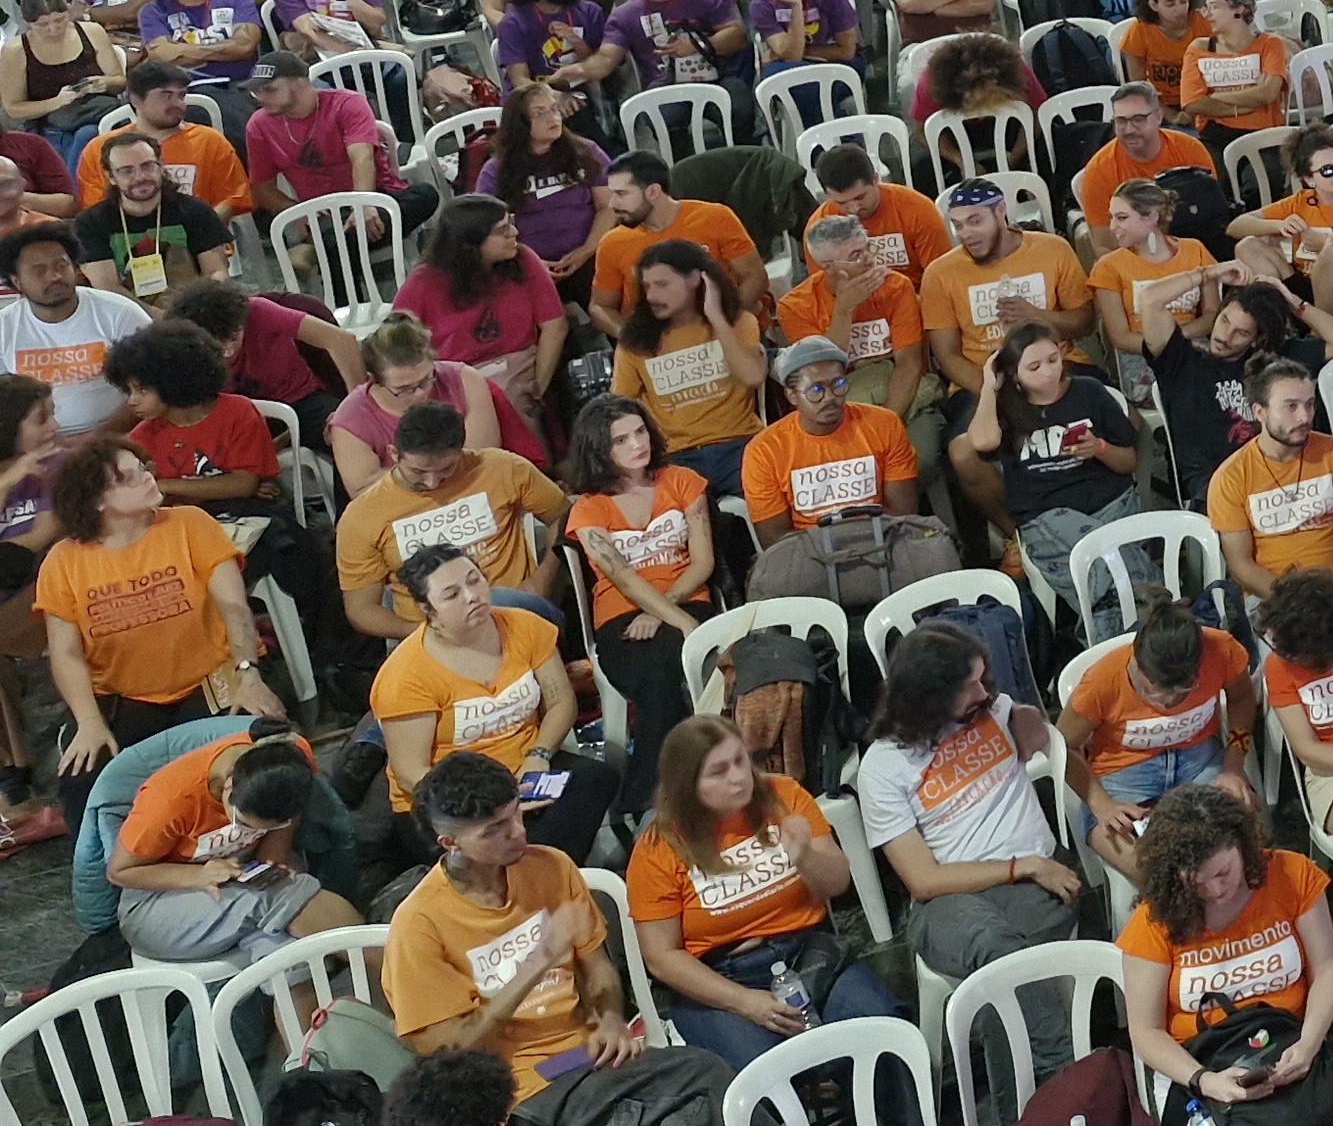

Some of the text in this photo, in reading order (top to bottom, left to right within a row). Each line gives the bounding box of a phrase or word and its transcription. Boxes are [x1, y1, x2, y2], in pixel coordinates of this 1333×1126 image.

[1203, 58, 1249, 72] nossa
[22, 347, 89, 366] nossa
[651, 346, 711, 376] nossa
[654, 359, 728, 392] CLASSE
[799, 460, 869, 485] nossa
[795, 476, 875, 508] CLASSE
[1257, 481, 1321, 512] nossa
[402, 503, 473, 538] nossa
[613, 518, 675, 552] nossa
[463, 682, 532, 722] nossa
[1131, 710, 1204, 737] nossa
[922, 734, 1008, 802] CLASSE
[476, 922, 542, 974] nossa
[1178, 920, 1292, 967] movimento
[1187, 951, 1285, 996] nossa
